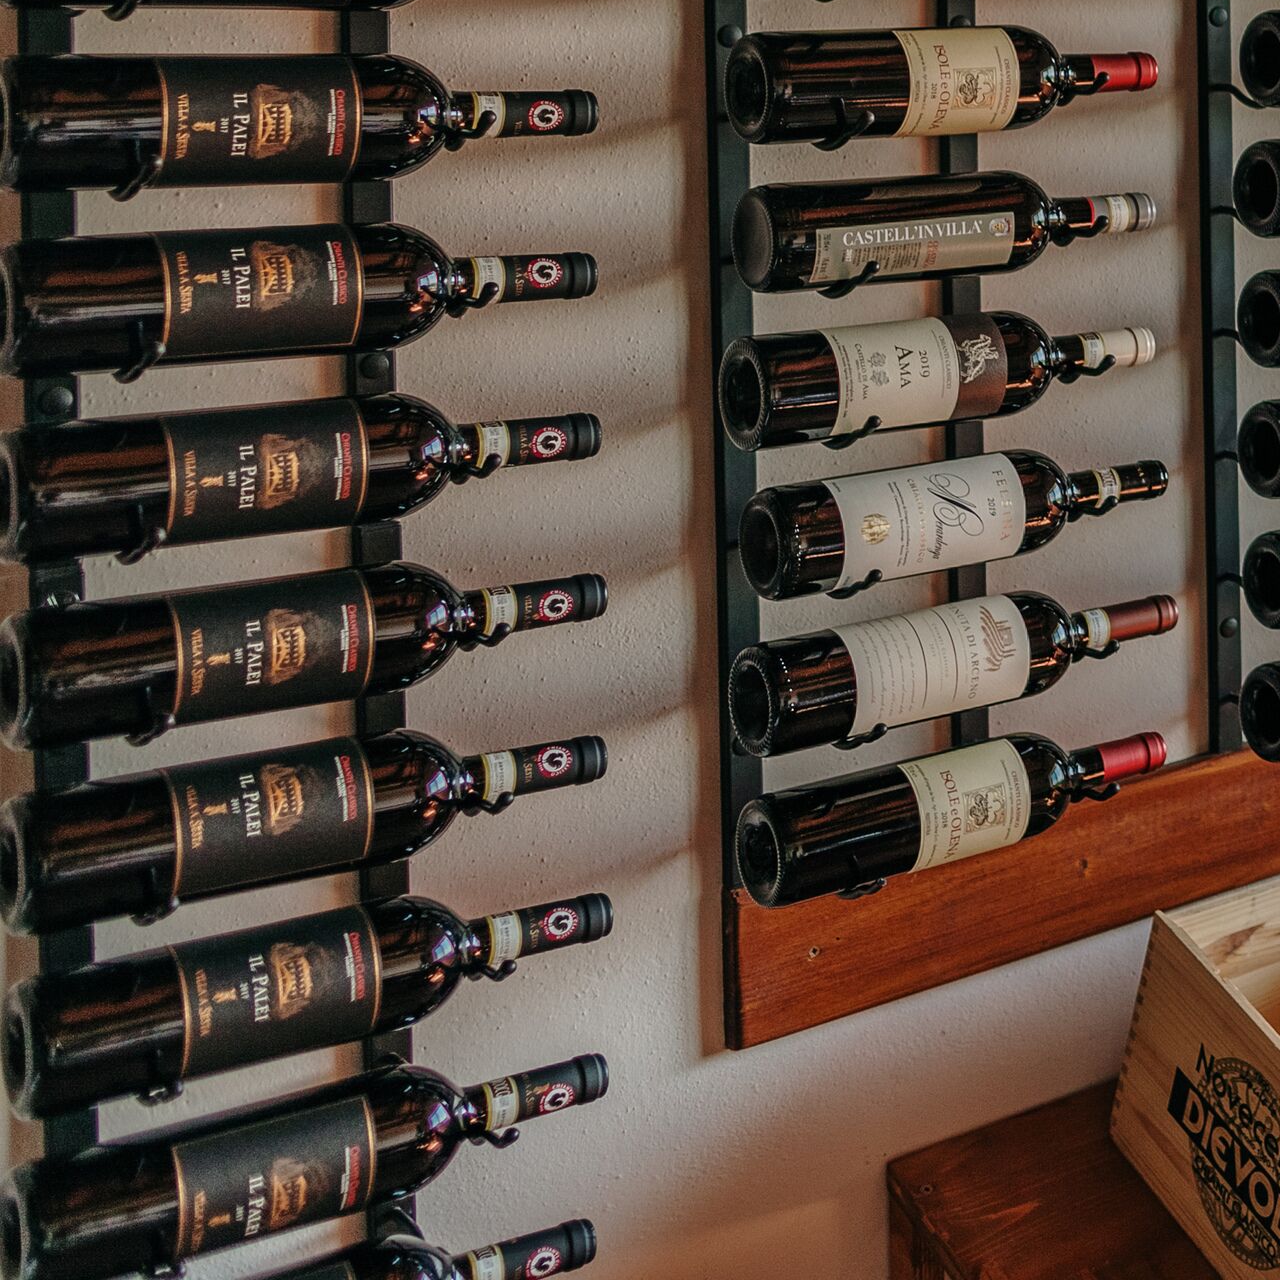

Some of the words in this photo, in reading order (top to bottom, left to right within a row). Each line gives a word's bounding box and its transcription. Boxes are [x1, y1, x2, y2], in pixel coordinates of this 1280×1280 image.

[933, 44, 951, 80] ISOLE
[232, 92, 248, 108] IL
[930, 82, 938, 100] 2018
[940, 81, 948, 90] e
[928, 90, 951, 130] OLENA
[230, 113, 251, 156] PALEI
[230, 248, 247, 261] IL
[233, 265, 251, 308] PALEI
[894, 345, 914, 389] AMA
[918, 350, 930, 378] 2019
[239, 444, 254, 461] IL
[238, 465, 257, 509] PALEI
[987, 497, 997, 516] 2019
[245, 620, 261, 638] IL
[967, 634, 977, 648] DI
[245, 640, 264, 686] PALEI
[239, 774, 255, 789] IL
[939, 770, 960, 807] ISOLE
[242, 791, 261, 837] PALEI
[944, 817, 962, 859] OLENA
[248, 954, 264, 972] IL
[251, 974, 270, 1022] PALEI
